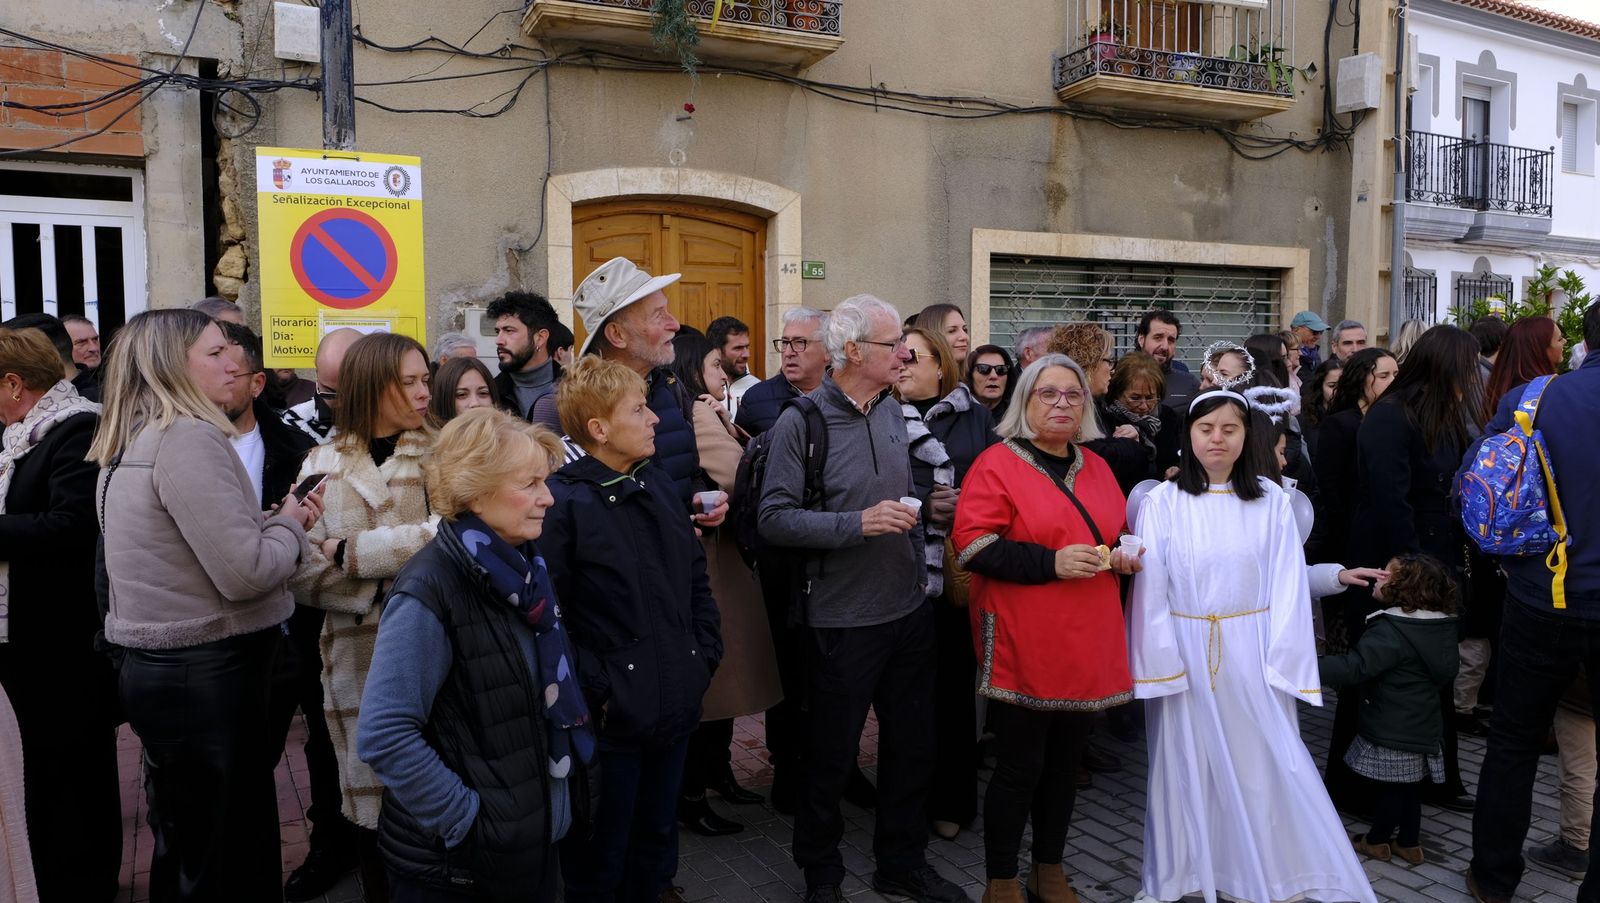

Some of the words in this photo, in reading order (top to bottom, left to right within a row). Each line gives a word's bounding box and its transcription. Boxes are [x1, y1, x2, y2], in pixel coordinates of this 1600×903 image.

[300, 168, 368, 178] AYUNTAMIENTO
[369, 171, 380, 179] DE
[305, 177, 323, 185] LOS
[324, 178, 376, 188] GALLARDOS
[272, 194, 343, 206] Señalización
[346, 198, 411, 210] Excepcional
[272, 318, 317, 327] Horario:
[273, 331, 294, 341] Día:
[273, 345, 313, 355] Motivo:
